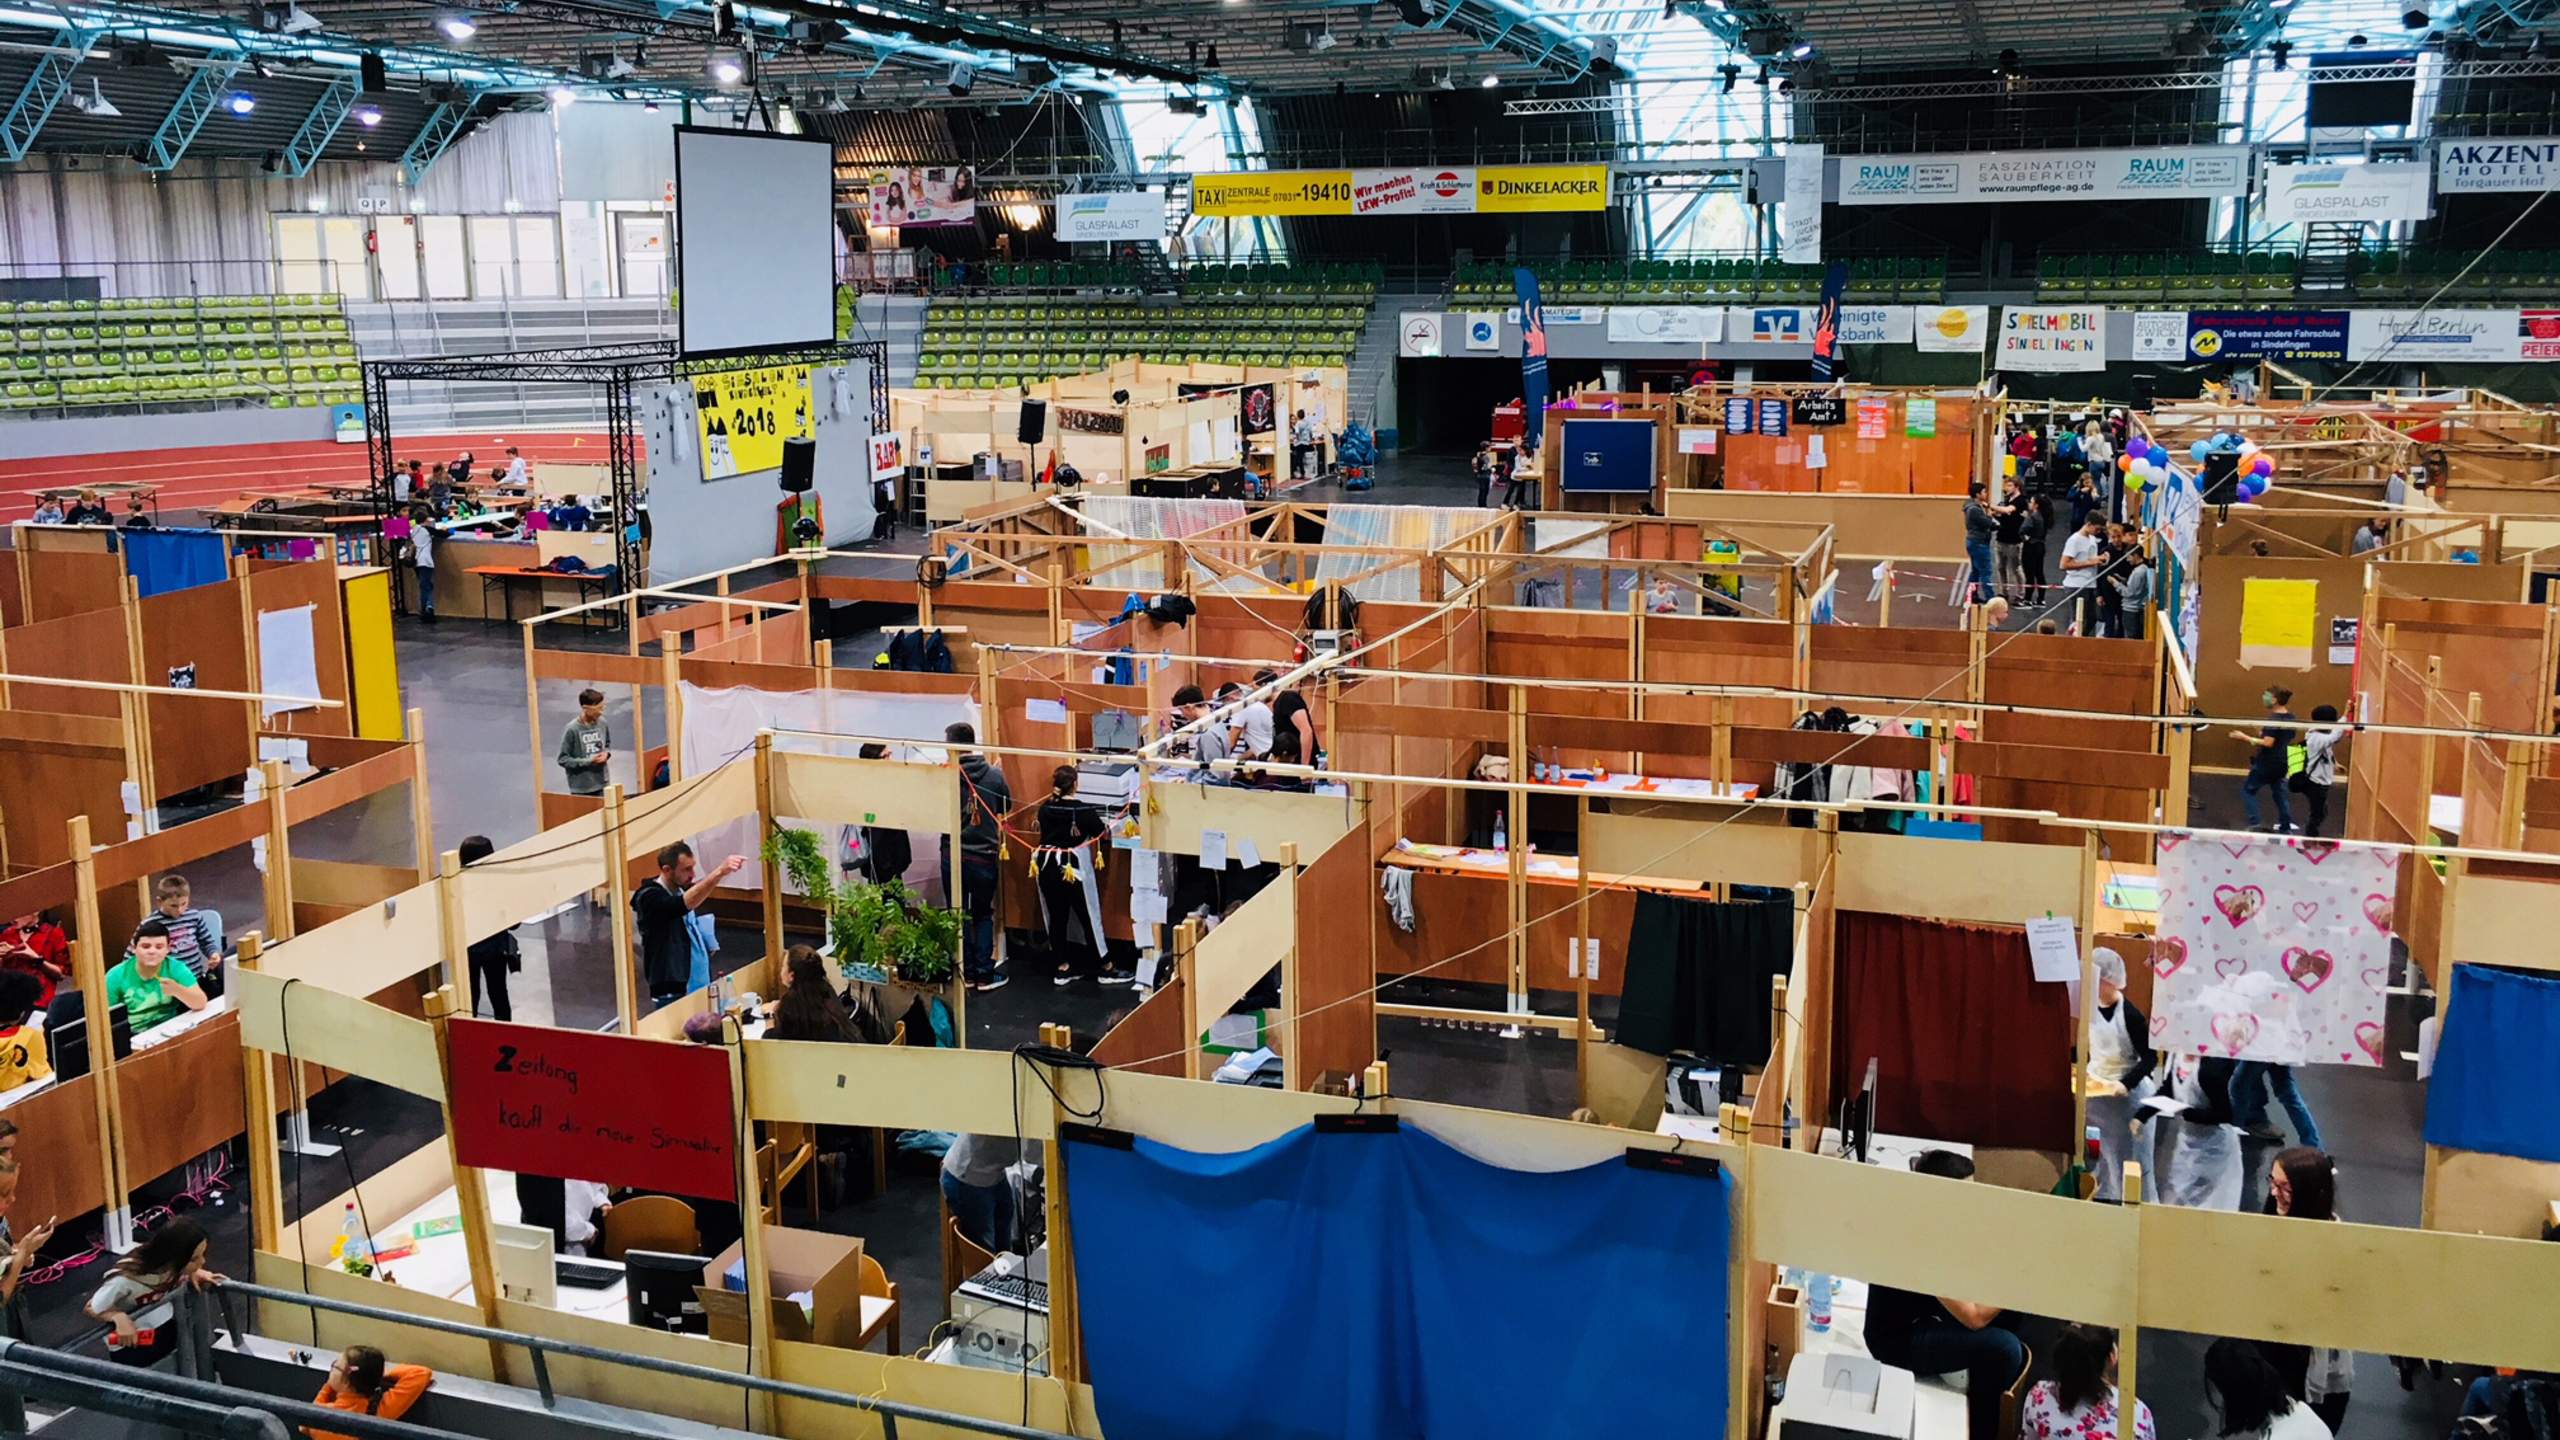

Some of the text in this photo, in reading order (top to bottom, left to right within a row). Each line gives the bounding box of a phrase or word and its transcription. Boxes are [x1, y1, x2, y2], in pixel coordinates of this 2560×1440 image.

[2446, 145, 2559, 165] AKZENT
[1860, 165, 1910, 178] RAUM
[1979, 160, 2096, 172] FASZINATION
[2130, 158, 2184, 172] RAUM
[1979, 170, 2094, 182] SAUBERKEIT
[2520, 176, 2545, 187] Hof
[1227, 186, 1271, 197] ZENTRALE
[1354, 174, 1413, 199] Wir machen
[1498, 180, 1600, 195] DINKELACKER
[1980, 182, 2095, 193] www.raumpflege-ag.de
[1198, 189, 1226, 205] TAXI
[1357, 186, 1416, 212] LKW-Profis!
[2294, 196, 2390, 209] GLASPALAST
[1075, 219, 1140, 231] GLASPALAST
[2222, 328, 2341, 338] Die etwas andere Fahrschule
[735, 407, 776, 437] 2018
[1809, 411, 1831, 421] Amt
[875, 441, 896, 471] BAR
[494, 1045, 578, 1095] Zeitung
